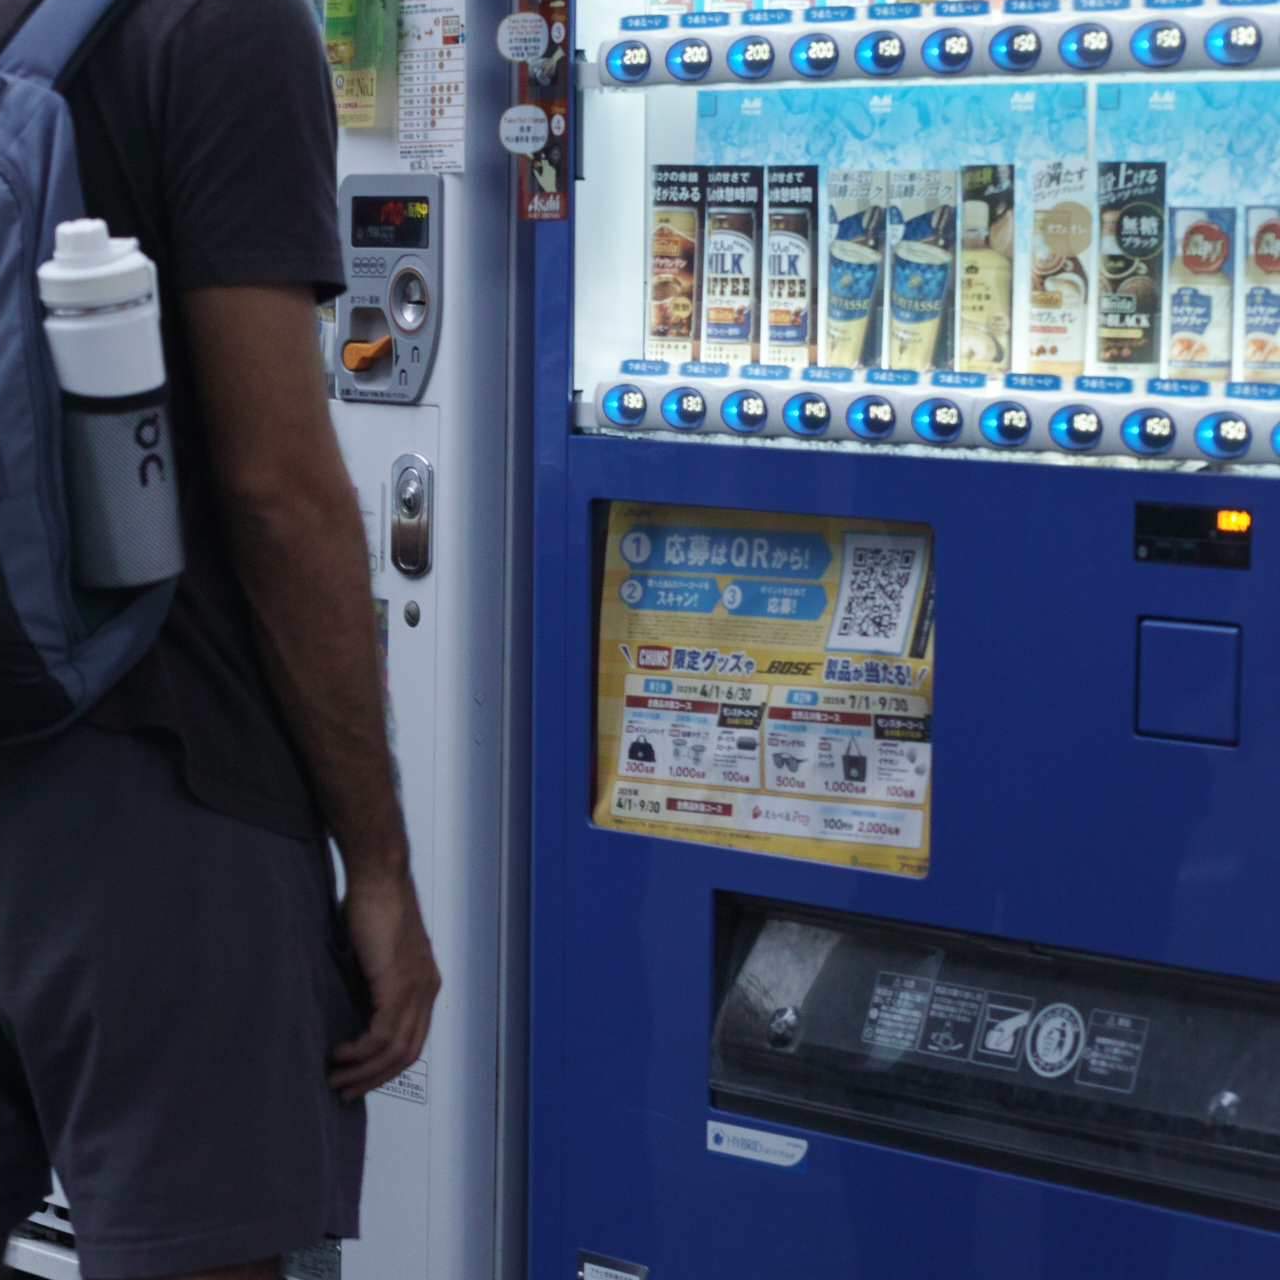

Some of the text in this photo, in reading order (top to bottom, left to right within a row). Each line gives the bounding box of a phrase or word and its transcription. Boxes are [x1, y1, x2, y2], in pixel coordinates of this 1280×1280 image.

[554, 26, 562, 39] 3
[1084, 31, 1108, 50] 150
[1157, 28, 1181, 47] 150
[1231, 26, 1256, 45] 130
[808, 41, 835, 59] 200
[879, 39, 901, 56] 150
[945, 36, 968, 54] 150
[1013, 33, 1036, 51] 150
[623, 48, 647, 65] 200
[683, 46, 708, 62] 200
[745, 43, 770, 60] 200
[356, 77, 375, 98] No.1
[554, 120, 562, 132] 4
[528, 194, 560, 212] Asahi
[1121, 216, 1159, 235] 無糖
[1121, 237, 1158, 249] ブラック
[1106, 314, 1150, 328] BLACK
[623, 393, 643, 409] 130
[682, 396, 702, 411] 130
[743, 398, 764, 415] 130
[805, 402, 826, 418] 140
[870, 405, 891, 421] 140
[936, 407, 958, 424] 160
[1146, 417, 1170, 435] 150
[631, 536, 642, 558] 1
[665, 535, 809, 570] 応募はQRから!
[627, 583, 637, 600] 2
[656, 591, 698, 607] スキャン!
[727, 588, 737, 604] 3
[767, 599, 797, 614] 応募!
[639, 649, 912, 687] CHUMS 限定グッズや BOSE 製品が当たる!
[700, 684, 752, 701] 4/1 6/30
[849, 695, 908, 712] 7/1 9/30
[616, 798, 660, 814] 4/1 9/30
